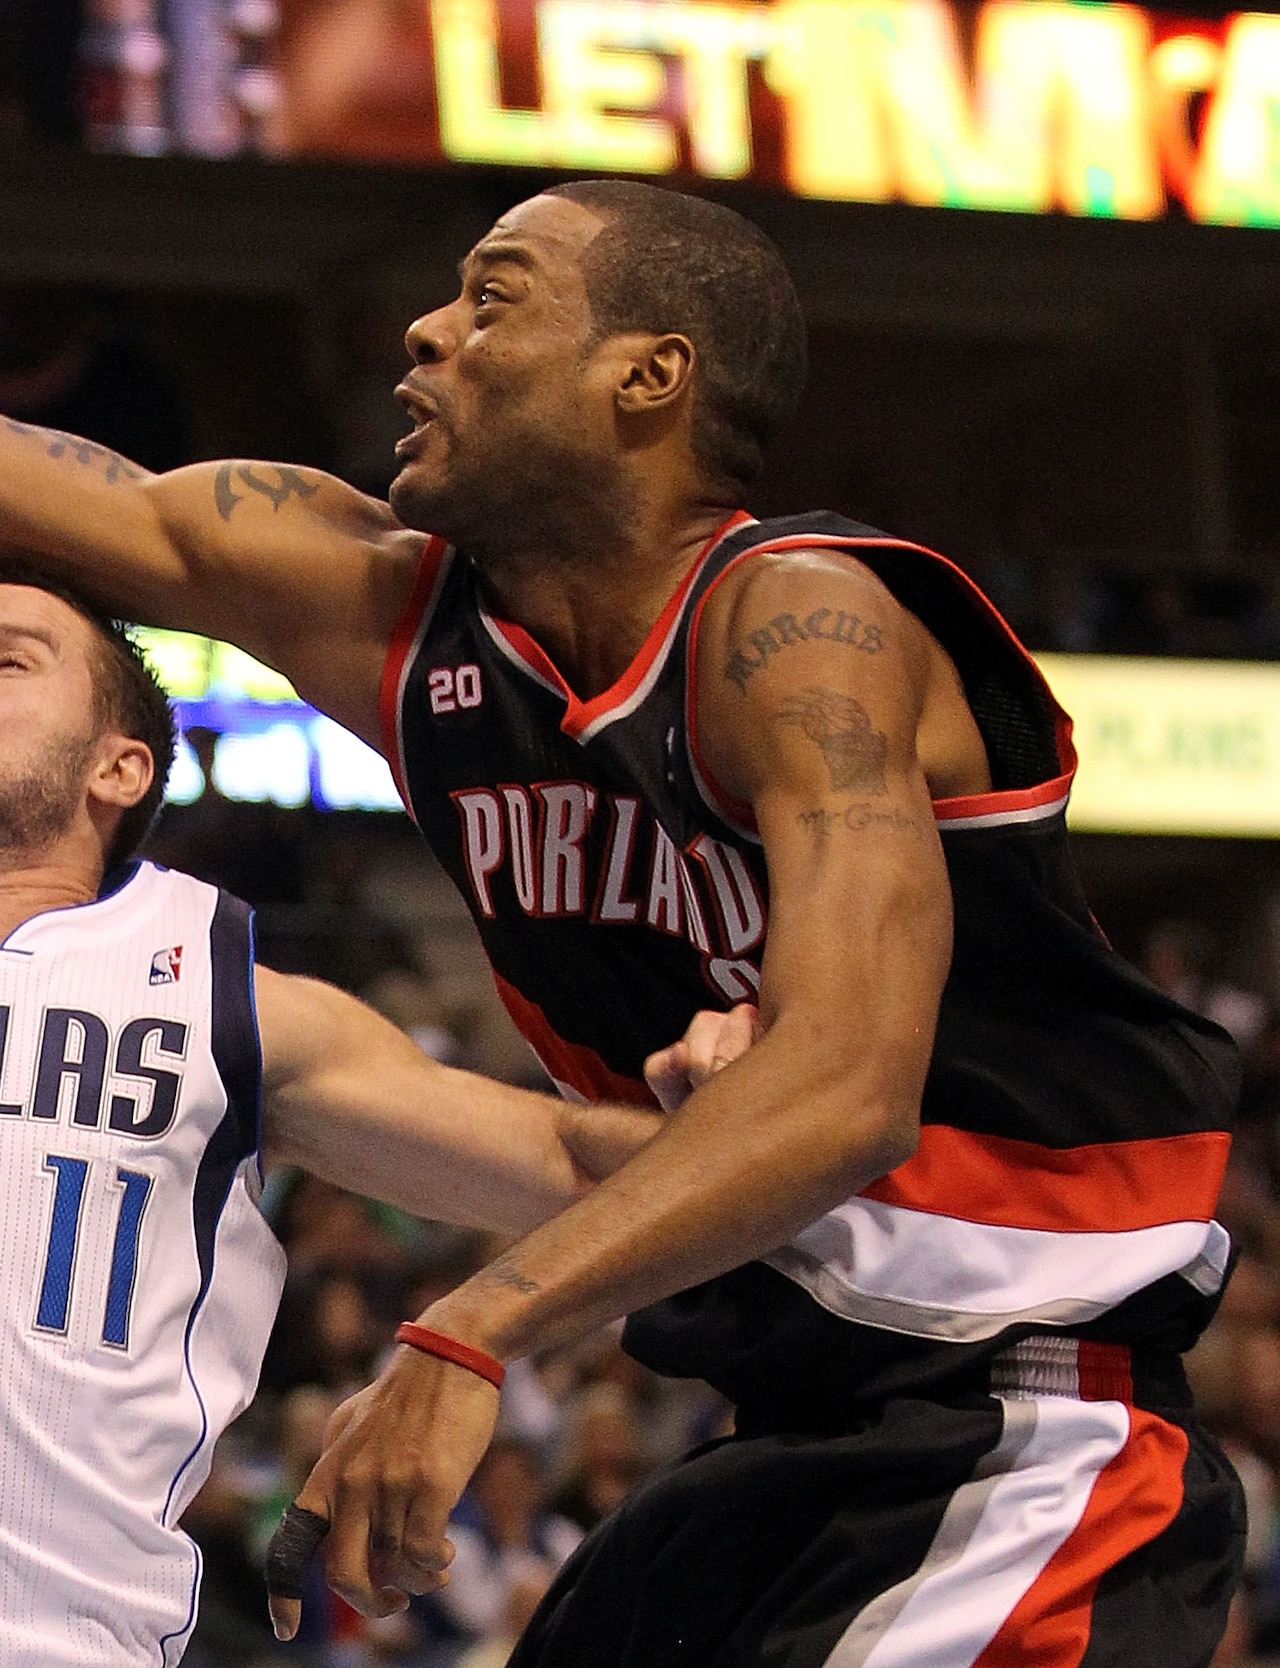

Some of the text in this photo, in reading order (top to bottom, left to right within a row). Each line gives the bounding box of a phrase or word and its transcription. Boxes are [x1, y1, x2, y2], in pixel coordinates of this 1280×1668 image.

[724, 608, 884, 692] MARCUS
[428, 663, 483, 715] 20
[150, 973, 172, 984] NBA
[32, 1150, 156, 1354] 11
